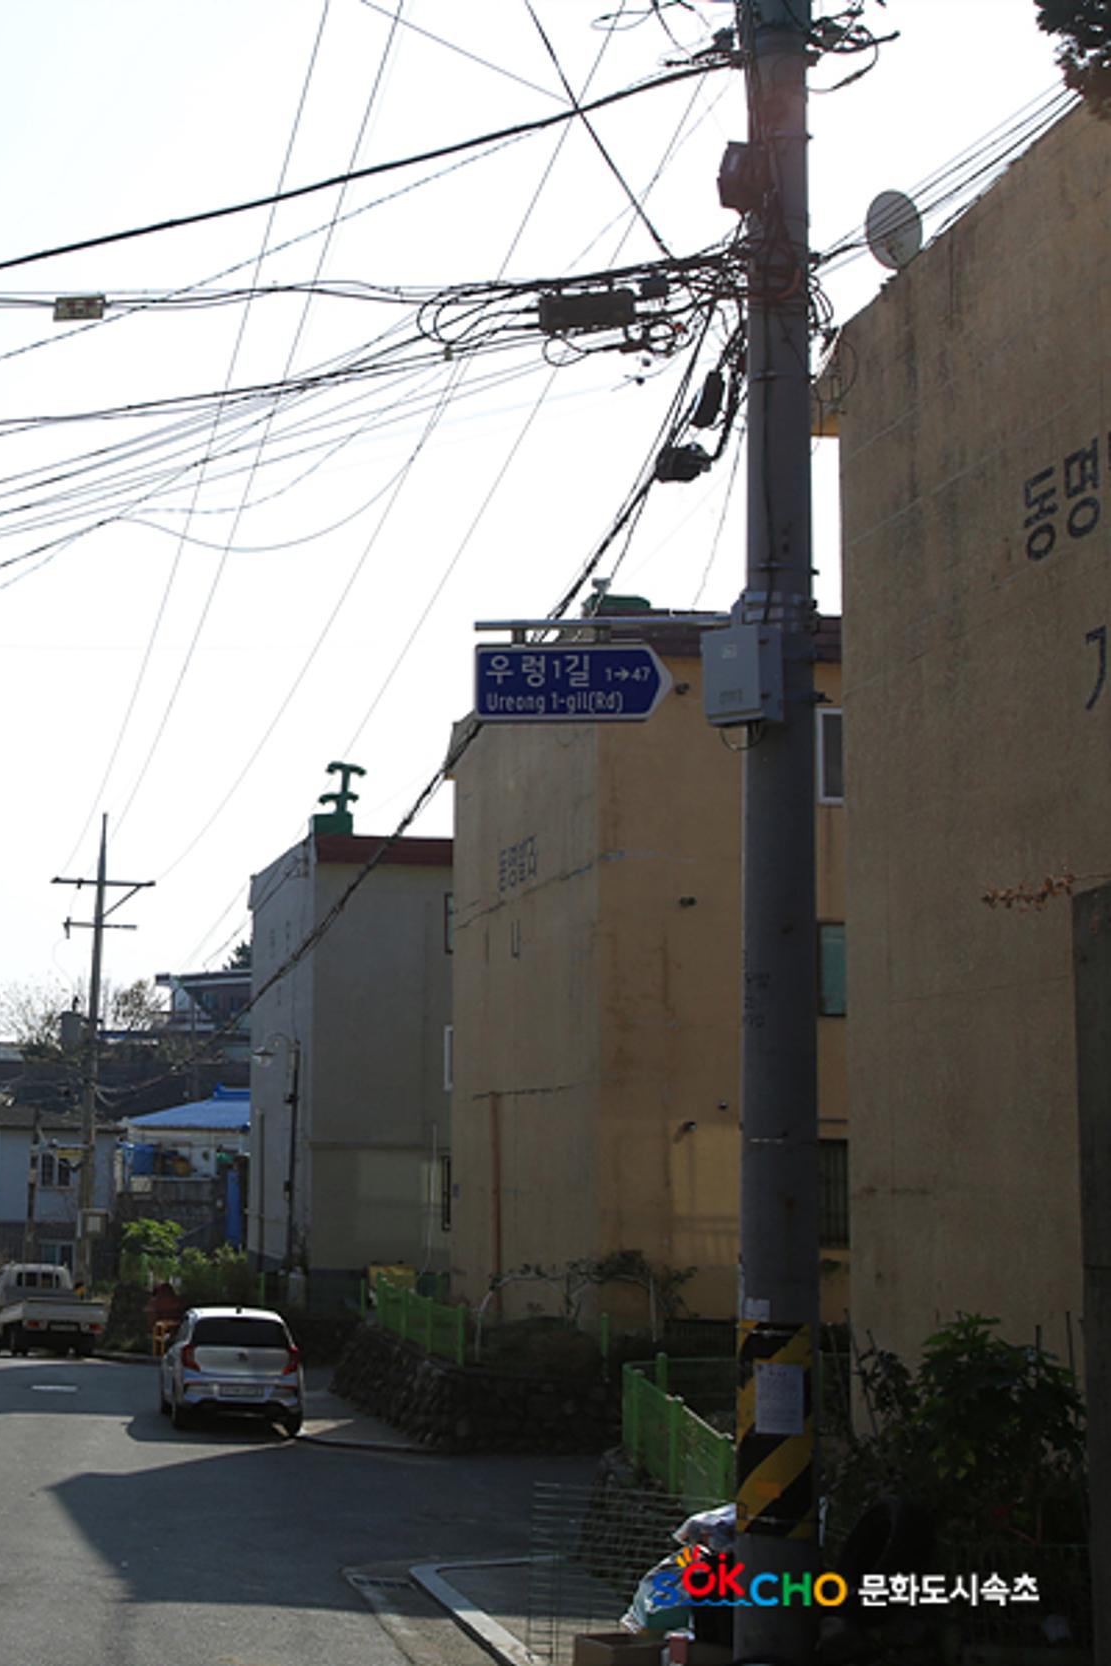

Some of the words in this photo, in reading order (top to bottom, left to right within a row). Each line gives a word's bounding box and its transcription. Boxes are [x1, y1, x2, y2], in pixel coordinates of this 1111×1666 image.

[1023, 430, 1111, 562] 동명
[486, 655, 590, 687] 우렁1길
[486, 692, 545, 714] Ureong
[551, 691, 623, 714] 1-gil(Rd)
